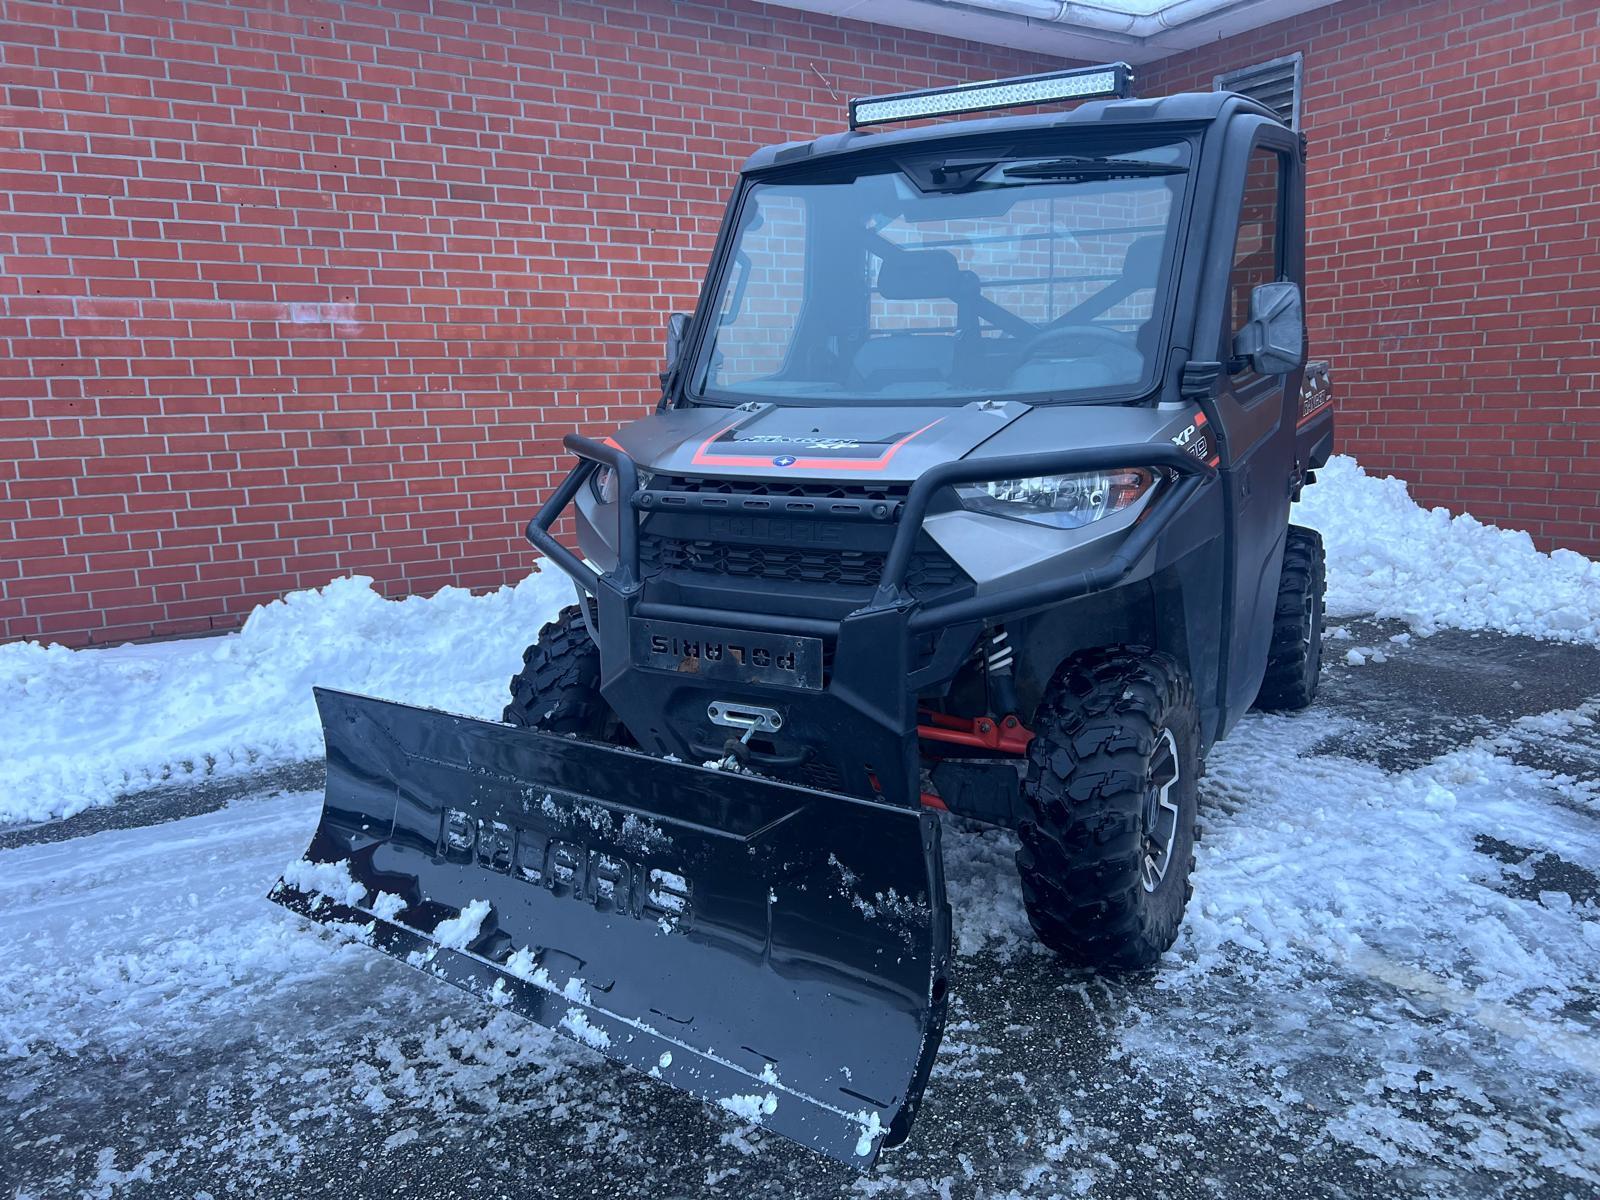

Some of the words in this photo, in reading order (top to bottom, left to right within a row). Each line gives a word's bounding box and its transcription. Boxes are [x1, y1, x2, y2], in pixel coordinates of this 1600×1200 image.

[805, 441, 860, 450] XP
[1171, 424, 1196, 446] XP
[651, 635, 796, 670] POLARIS
[434, 806, 694, 936] POLARIS
